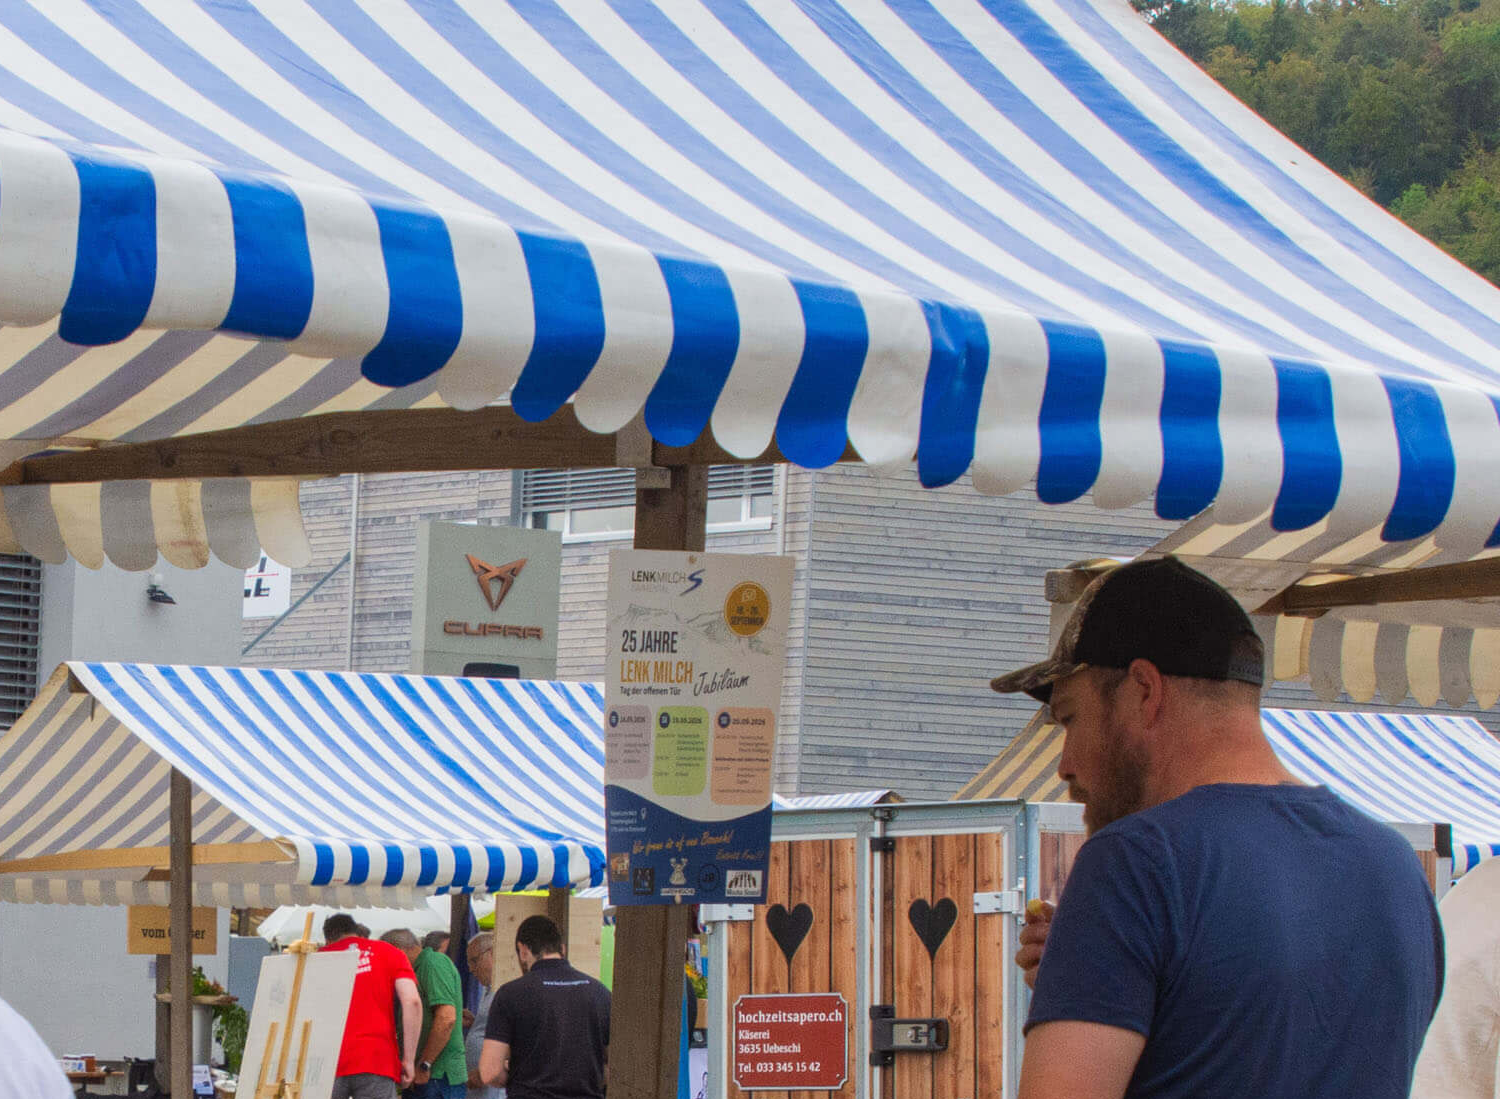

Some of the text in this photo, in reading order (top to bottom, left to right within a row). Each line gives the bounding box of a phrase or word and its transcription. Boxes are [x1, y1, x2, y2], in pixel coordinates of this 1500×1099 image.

[631, 570, 687, 583] LENKMILCH
[444, 620, 543, 640] CUPRA
[621, 630, 678, 653] 25 JAHRE
[620, 660, 693, 684] LENK MILCH
[693, 668, 750, 696] Jubiläum
[620, 686, 681, 696] Tag der offenen Tür
[141, 928, 165, 939] vom
[738, 1009, 842, 1025] hochzeitsapero.ch
[738, 1030, 770, 1040] Käserei
[738, 1043, 801, 1054] 3635 Uebeschi
[738, 1062, 820, 1073] Tel. 033 345 15 42
